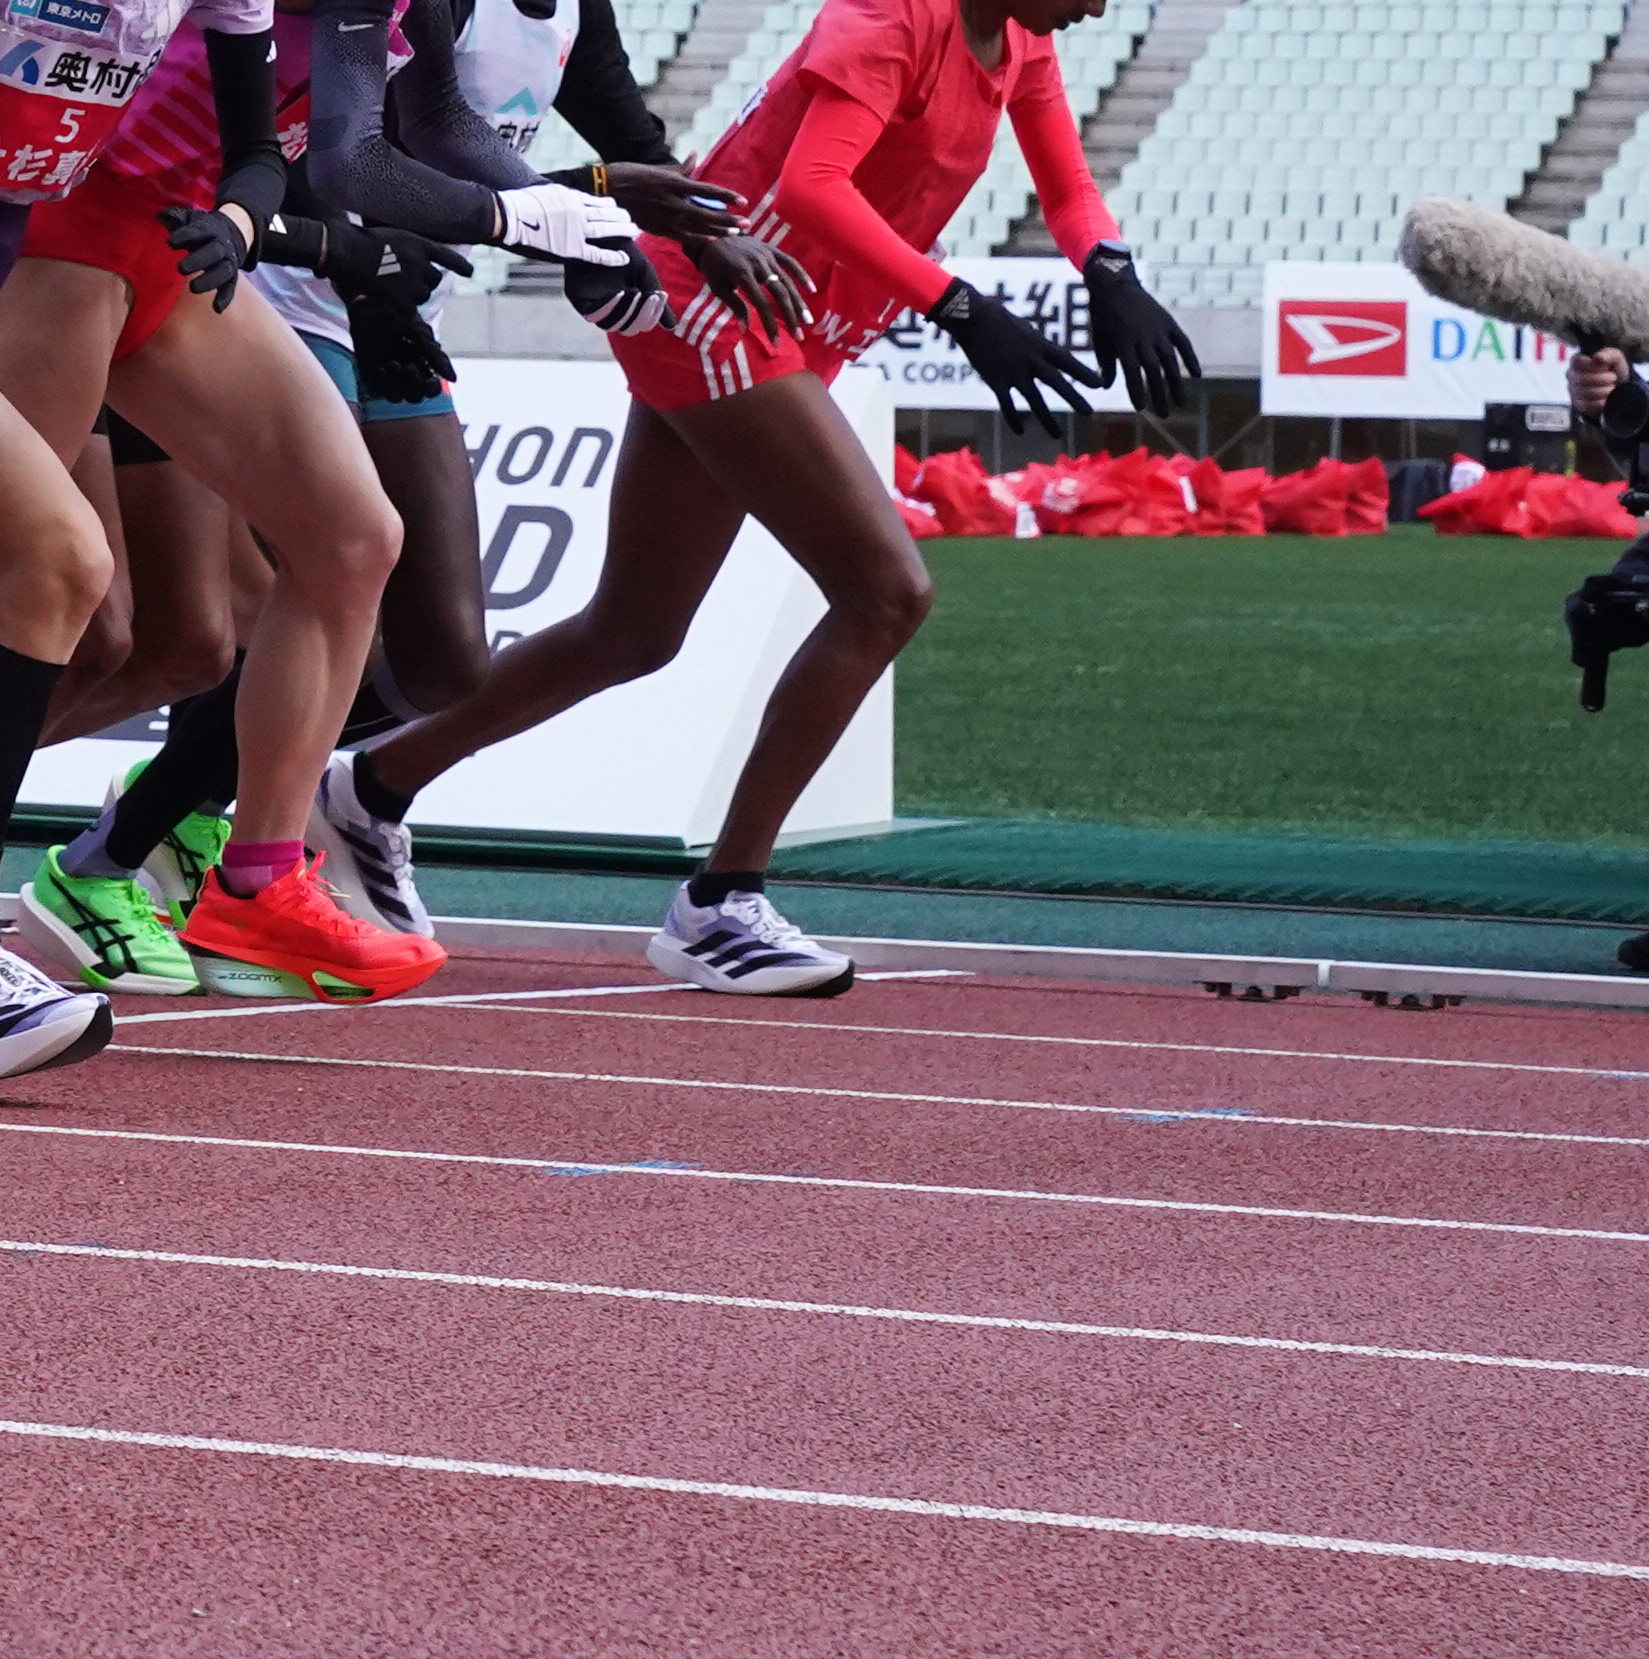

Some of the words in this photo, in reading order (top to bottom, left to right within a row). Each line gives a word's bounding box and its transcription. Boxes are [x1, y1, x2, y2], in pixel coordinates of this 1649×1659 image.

[45, 0, 103, 26] 東京メトロ
[53, 107, 87, 145] 5
